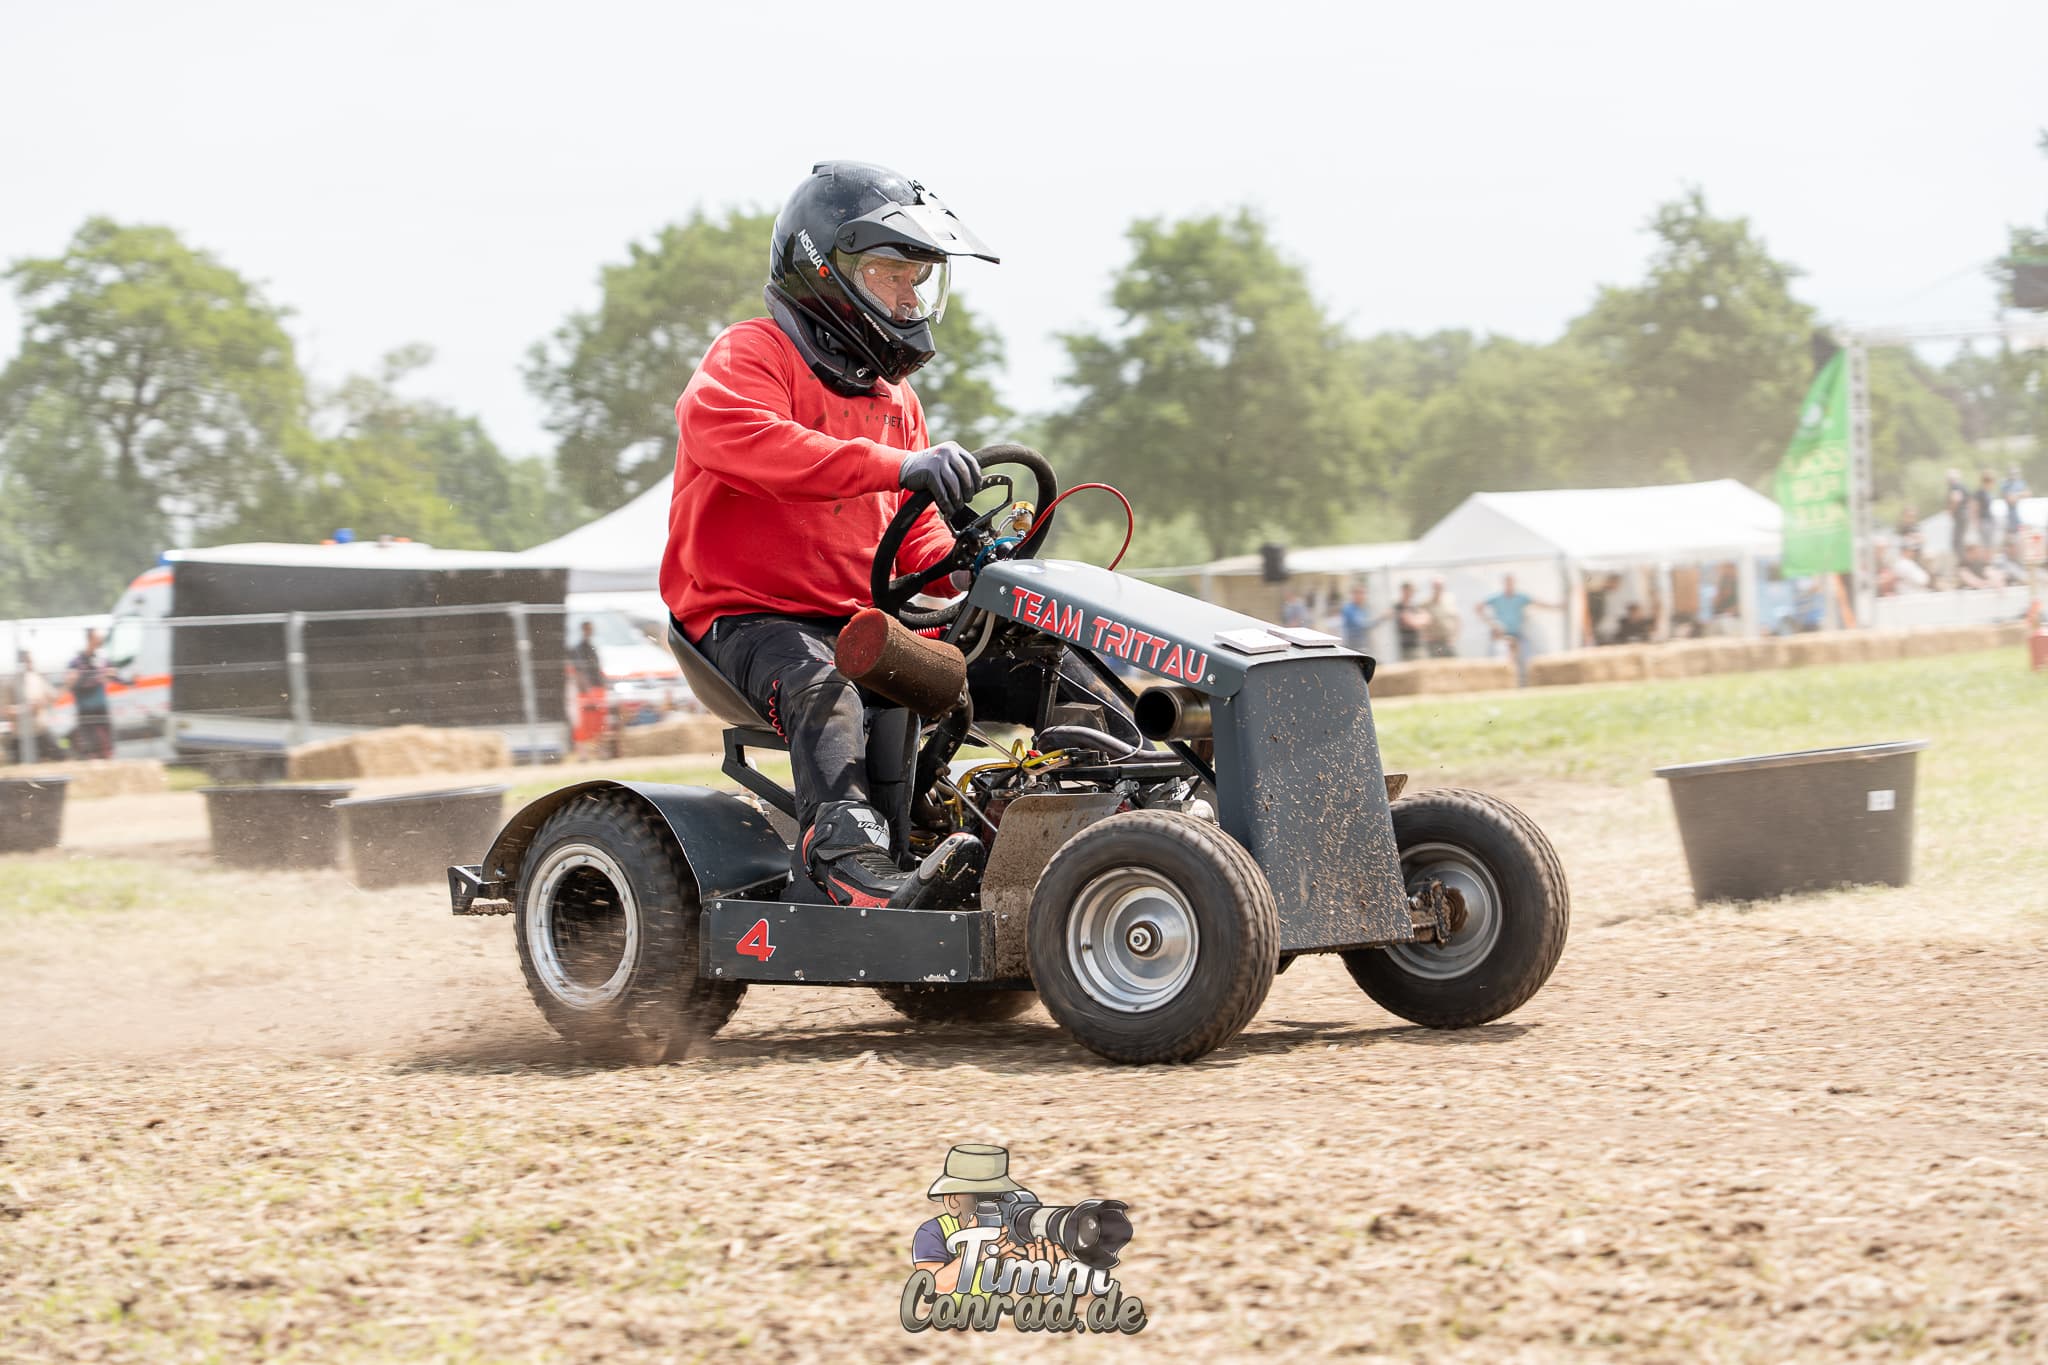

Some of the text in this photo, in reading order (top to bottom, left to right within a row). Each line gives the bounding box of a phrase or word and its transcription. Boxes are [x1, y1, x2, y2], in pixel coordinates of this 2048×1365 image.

[797, 228, 825, 271] NISHUA
[1011, 586, 1208, 684] TEAM TRITTAU
[736, 918, 776, 962] 4
